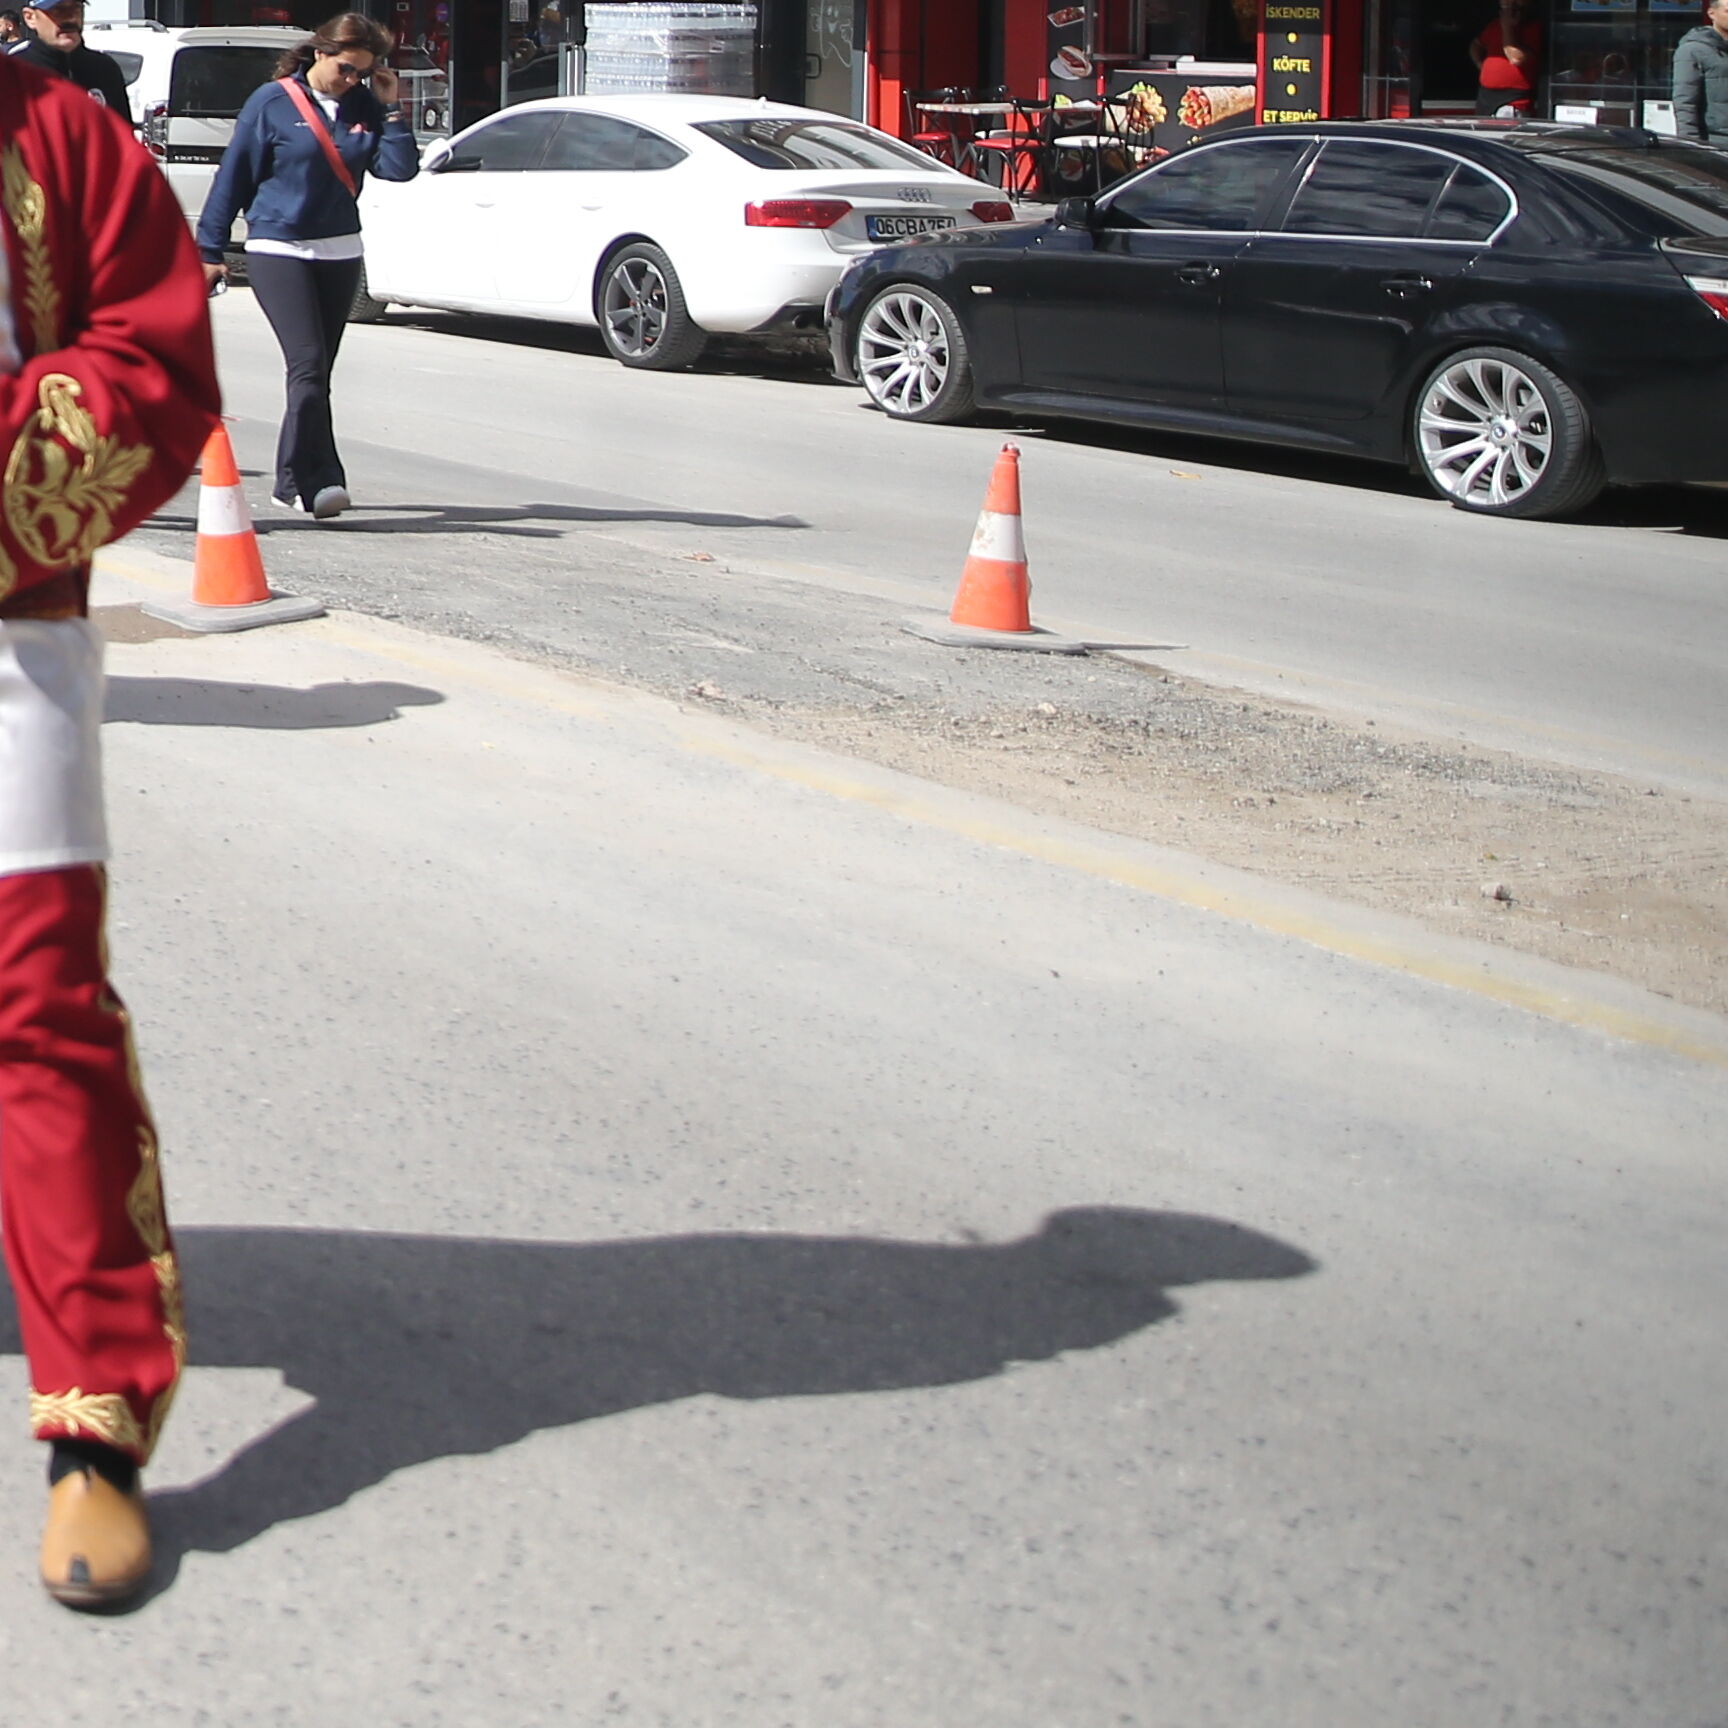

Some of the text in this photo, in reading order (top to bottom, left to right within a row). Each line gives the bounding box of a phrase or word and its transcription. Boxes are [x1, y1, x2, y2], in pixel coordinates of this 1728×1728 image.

[1265, 3, 1321, 20] İSKENDER
[1273, 55, 1311, 73] KÖFTE
[1263, 110, 1280, 123] ET
[875, 216, 895, 235] 06
[894, 216, 927, 236] CBA
